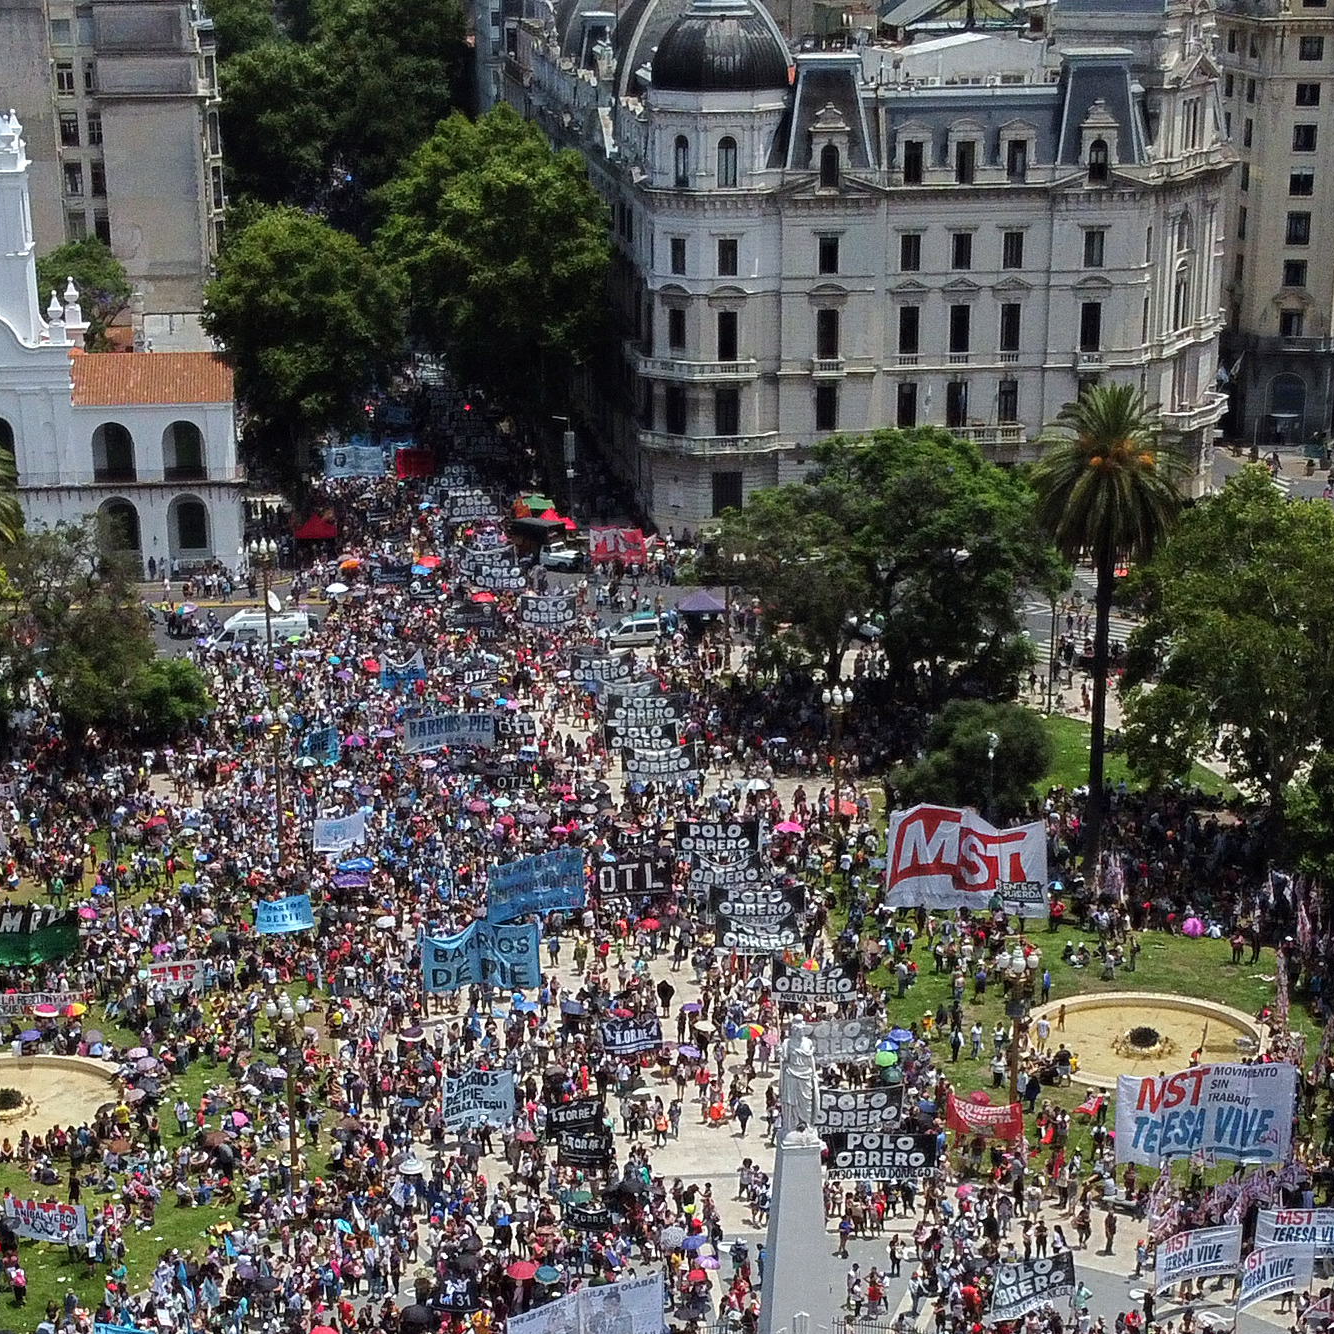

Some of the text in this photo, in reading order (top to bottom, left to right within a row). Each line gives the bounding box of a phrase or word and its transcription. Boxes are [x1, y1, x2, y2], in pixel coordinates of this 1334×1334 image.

[458, 496, 491, 505] POLO
[482, 566, 520, 577] POLO
[475, 576, 525, 588] OBRERO
[528, 599, 566, 611] POLO
[522, 610, 574, 623] OBRERO
[580, 658, 621, 670] POLO
[573, 665, 629, 680] OBRERO
[622, 698, 667, 708] POLO
[615, 707, 675, 718] OBRERO
[409, 715, 460, 737] BARRIOS
[468, 714, 491, 732] PIE
[498, 720, 535, 736] OTL
[611, 738, 673, 748] OBRERO
[634, 748, 682, 760] POLO
[627, 758, 690, 773] OBRERO
[689, 825, 742, 838] POLO
[681, 837, 750, 850] OBRERO
[897, 811, 1027, 885] MST
[691, 868, 758, 884] OBRERO
[728, 889, 783, 902] POLO
[719, 901, 793, 916] OBRERO
[723, 929, 795, 948] OBRERO
[433, 930, 530, 963] BARRIOS
[431, 957, 528, 988] DE PIE
[775, 977, 852, 993] OBRERO
[445, 1071, 498, 1093] BARRIOS
[1210, 1079, 1229, 1089] SIN
[821, 1092, 888, 1111] POLO
[1208, 1093, 1250, 1107] TRABAJO
[815, 1105, 898, 1126] OBRERO
[1214, 1106, 1274, 1147] VIVE
[847, 1133, 915, 1149] POLO
[836, 1151, 925, 1167] OBRERO
[1275, 1210, 1313, 1225] MST
[1273, 1225, 1317, 1242] TERESA
[1197, 1244, 1222, 1262] VIVE
[1269, 1258, 1294, 1280] VIVE
